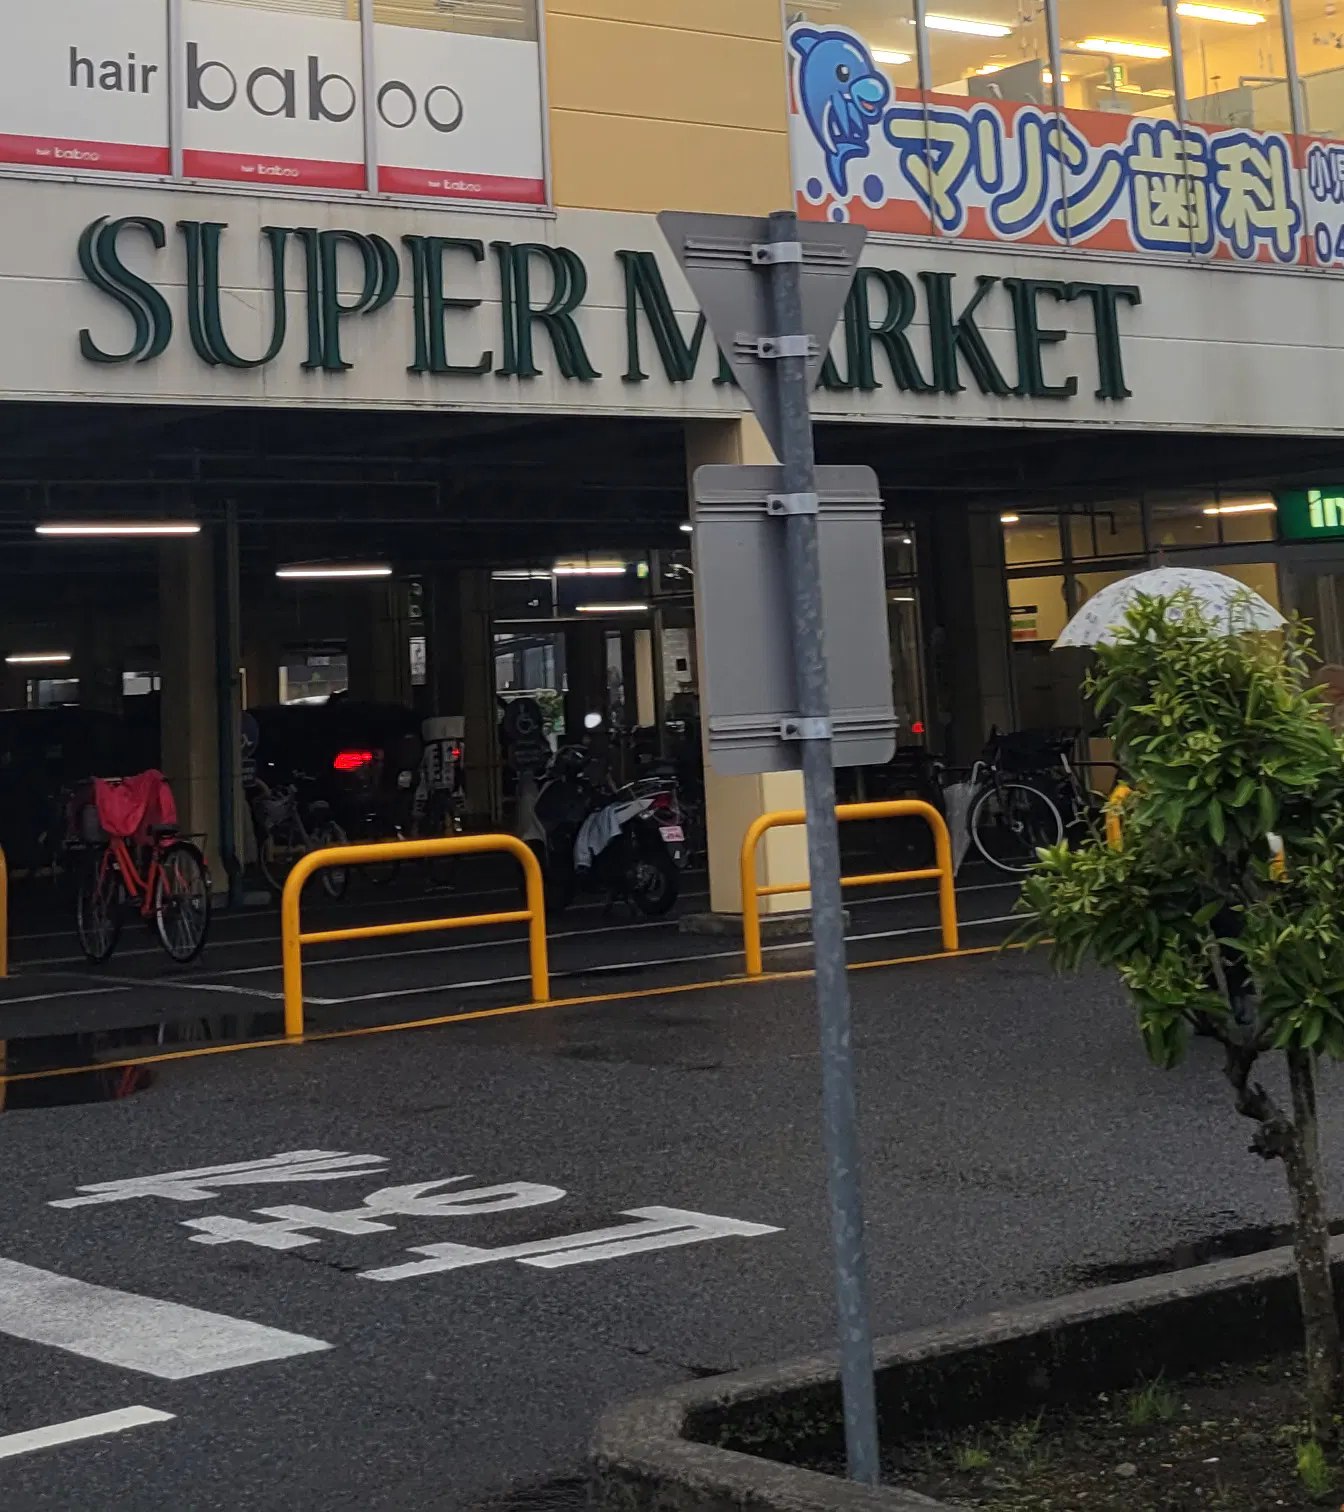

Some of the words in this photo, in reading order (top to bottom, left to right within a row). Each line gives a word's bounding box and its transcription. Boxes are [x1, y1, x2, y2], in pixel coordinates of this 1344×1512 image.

[68, 45, 158, 94] hair
[186, 41, 464, 133] baboo
[884, 107, 1300, 263] マリン歯科
[47, 1150, 785, 1281] 止まれ
